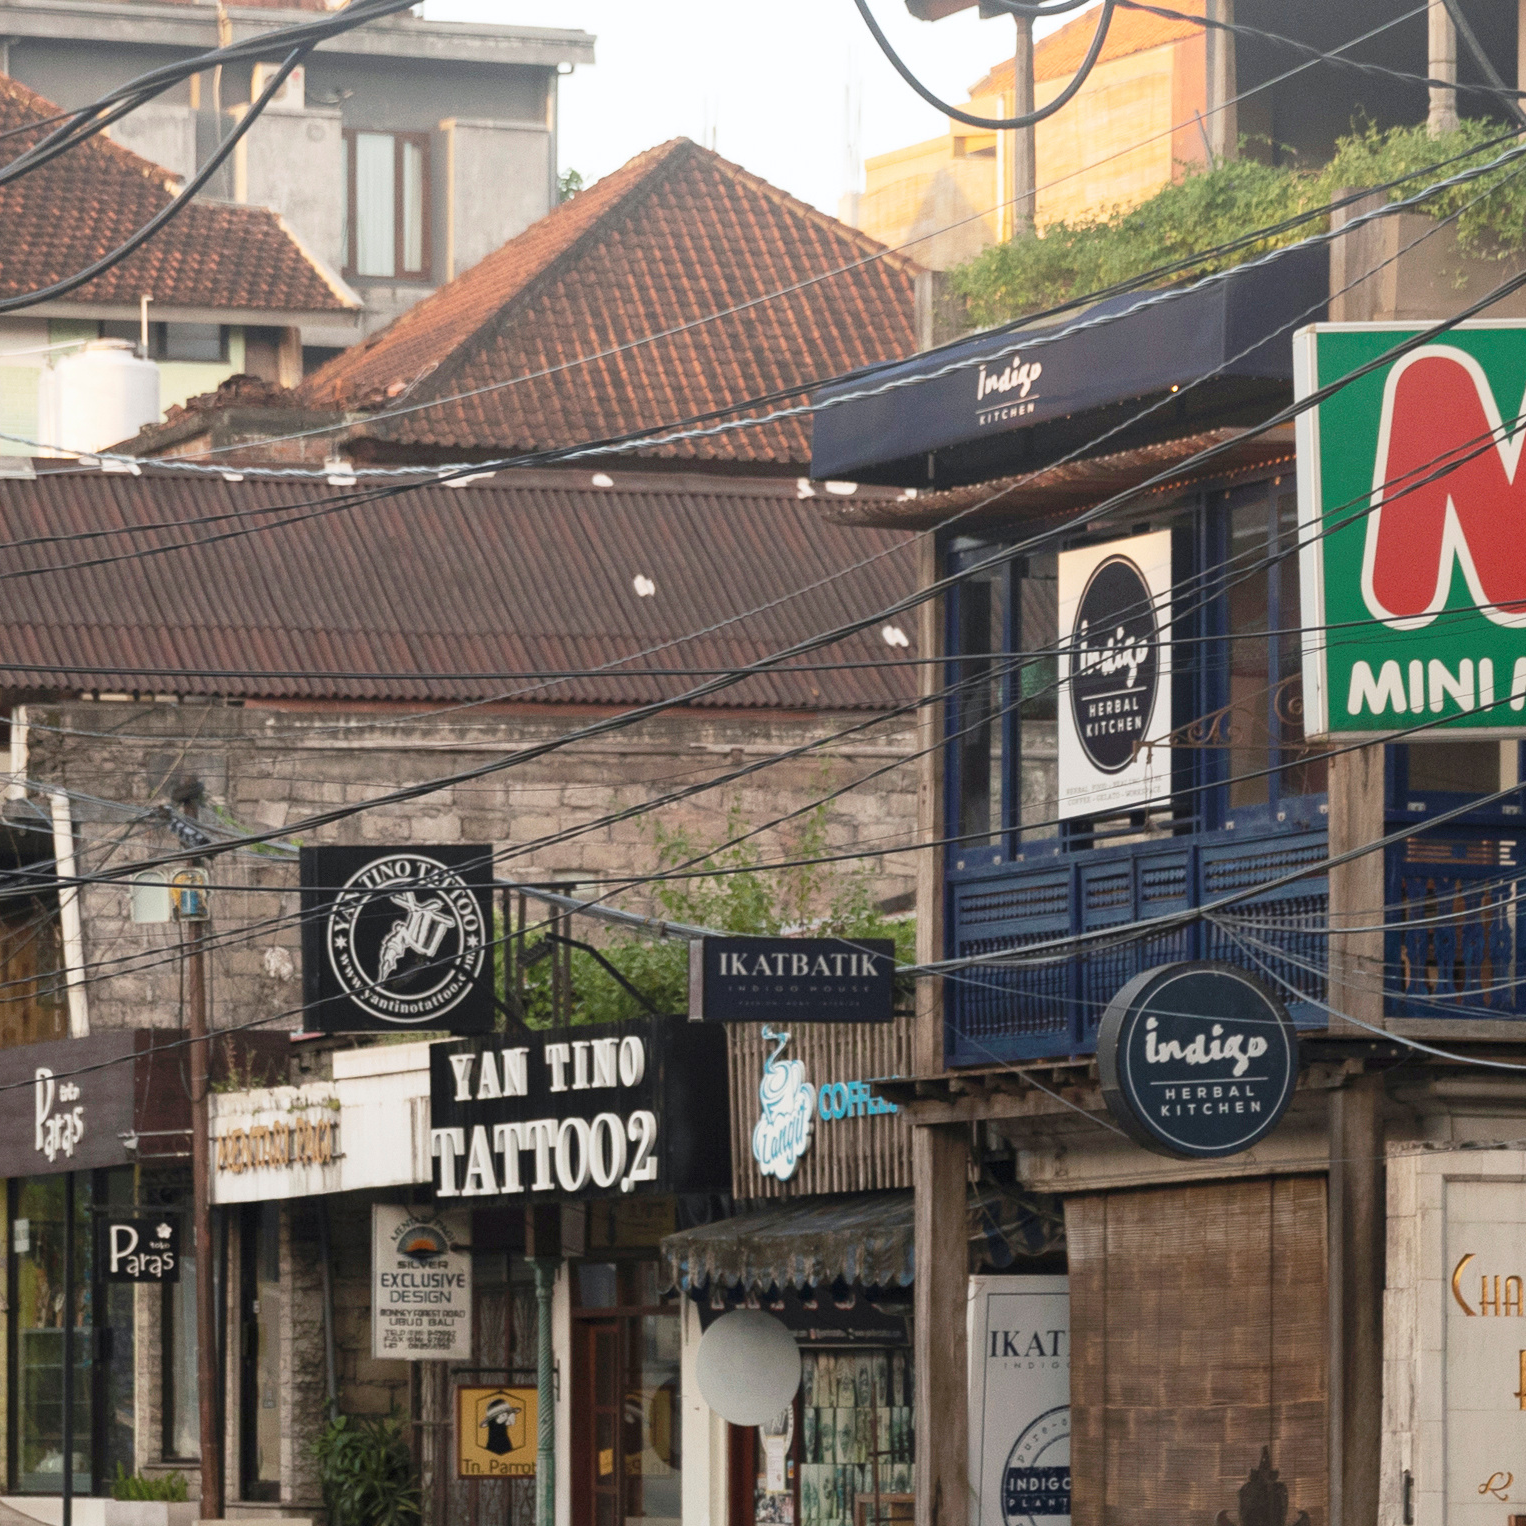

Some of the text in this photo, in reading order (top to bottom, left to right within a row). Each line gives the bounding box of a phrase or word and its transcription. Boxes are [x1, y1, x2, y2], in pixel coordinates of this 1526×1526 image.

[979, 402, 1035, 426] KITCHEN
[1347, 657, 1494, 715] MINI
[1089, 697, 1139, 718] HERBAL
[1086, 716, 1142, 738] KITCHEN
[358, 860, 411, 889] TINO
[719, 953, 879, 977] IKATBATIK
[449, 1036, 645, 1101] YAN TINO
[1165, 1085, 1254, 1100] HERBAL
[1161, 1101, 1261, 1117] KITCHEN
[110, 1224, 174, 1278] Paras
[397, 1260, 449, 1269] SILVER
[381, 1273, 466, 1289] EXCLUSIVE
[390, 1290, 452, 1303] DESIGN
[389, 1318, 455, 1327] UBUD BALI
[989, 1330, 1071, 1358] IKAT
[463, 1459, 537, 1474] Tn. Parrot
